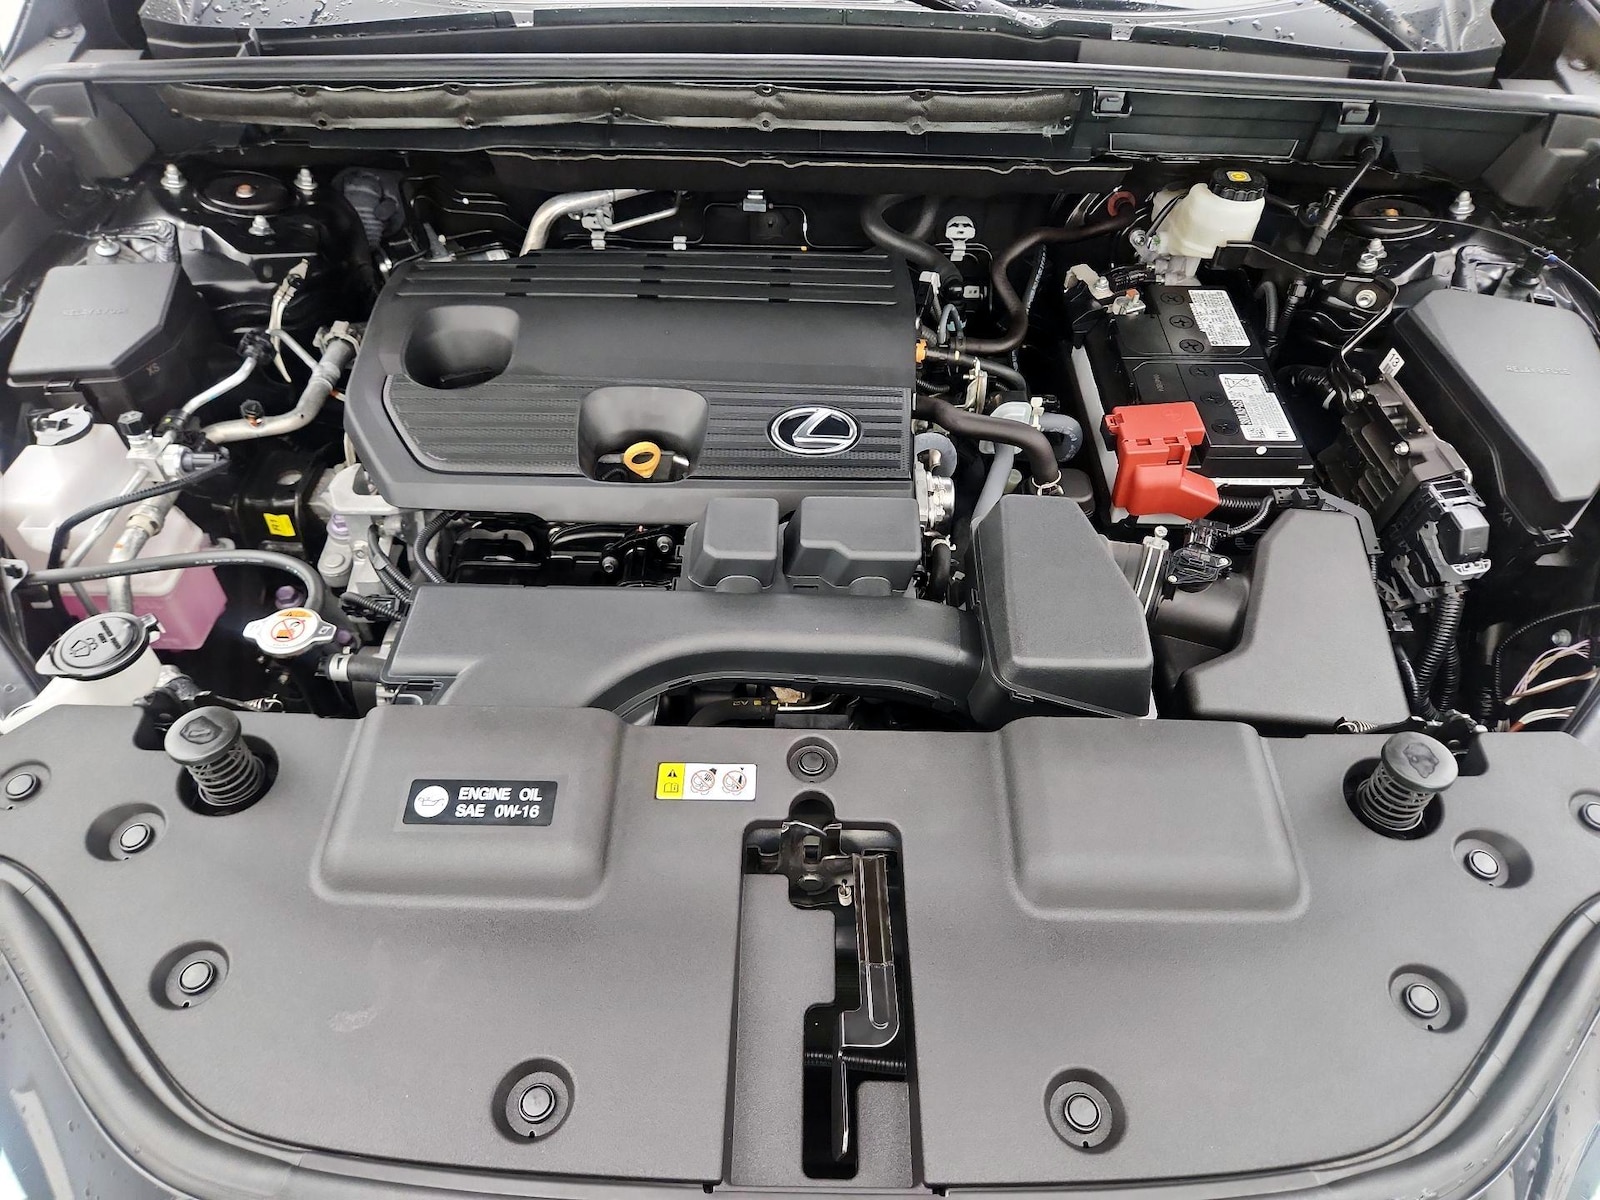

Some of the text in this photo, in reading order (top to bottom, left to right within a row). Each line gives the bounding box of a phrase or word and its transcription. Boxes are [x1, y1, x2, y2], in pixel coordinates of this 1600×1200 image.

[458, 786, 543, 802] ENGINE OIL
[455, 804, 540, 819] SAE 0W-16
